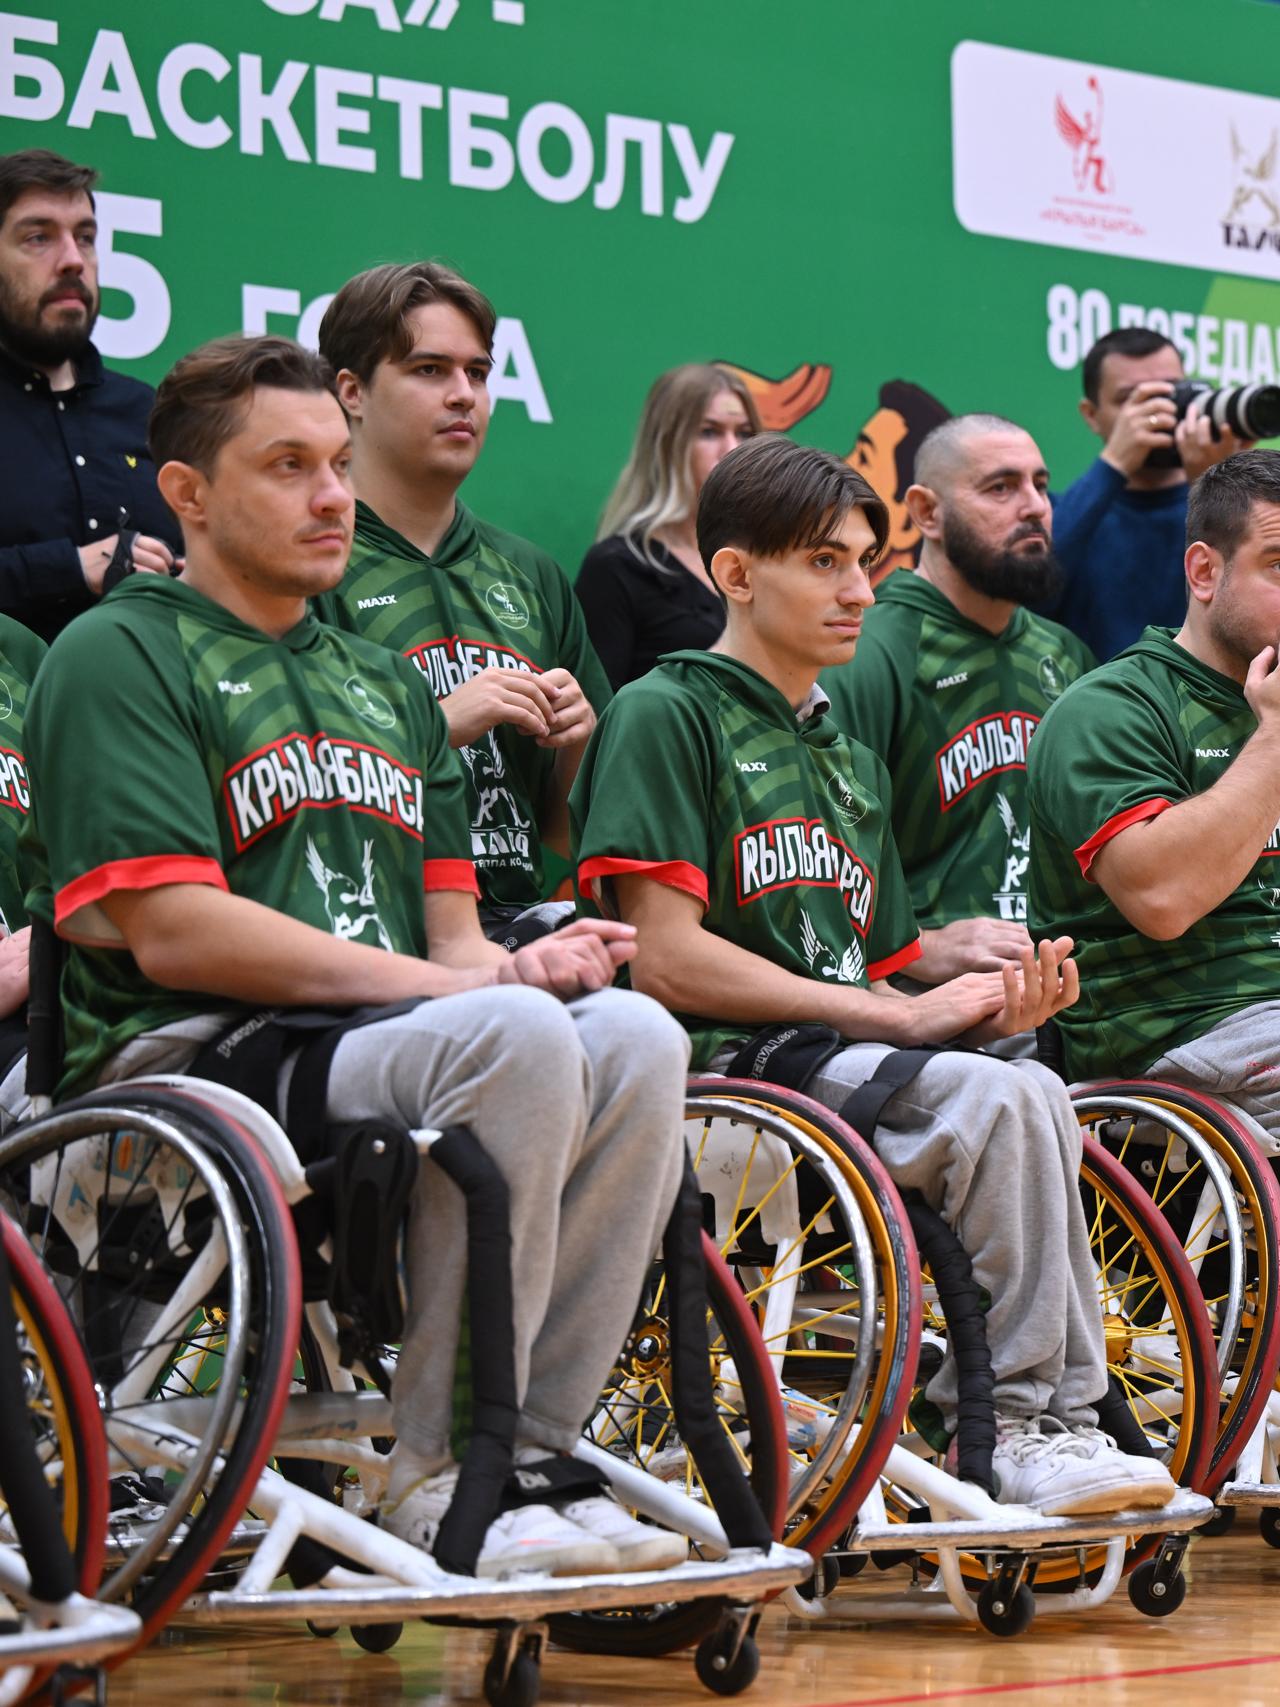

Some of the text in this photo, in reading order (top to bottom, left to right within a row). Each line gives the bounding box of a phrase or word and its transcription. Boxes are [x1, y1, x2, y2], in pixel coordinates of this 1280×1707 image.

[0, 13, 735, 224] БАСКЕТБОЛУ
[357, 594, 397, 610] MAXX
[936, 671, 968, 690] MAXX
[939, 717, 1025, 802] КРЫЛЬЯ
[1195, 748, 1231, 758] MAXX
[230, 739, 344, 840] КРЫЬЯ
